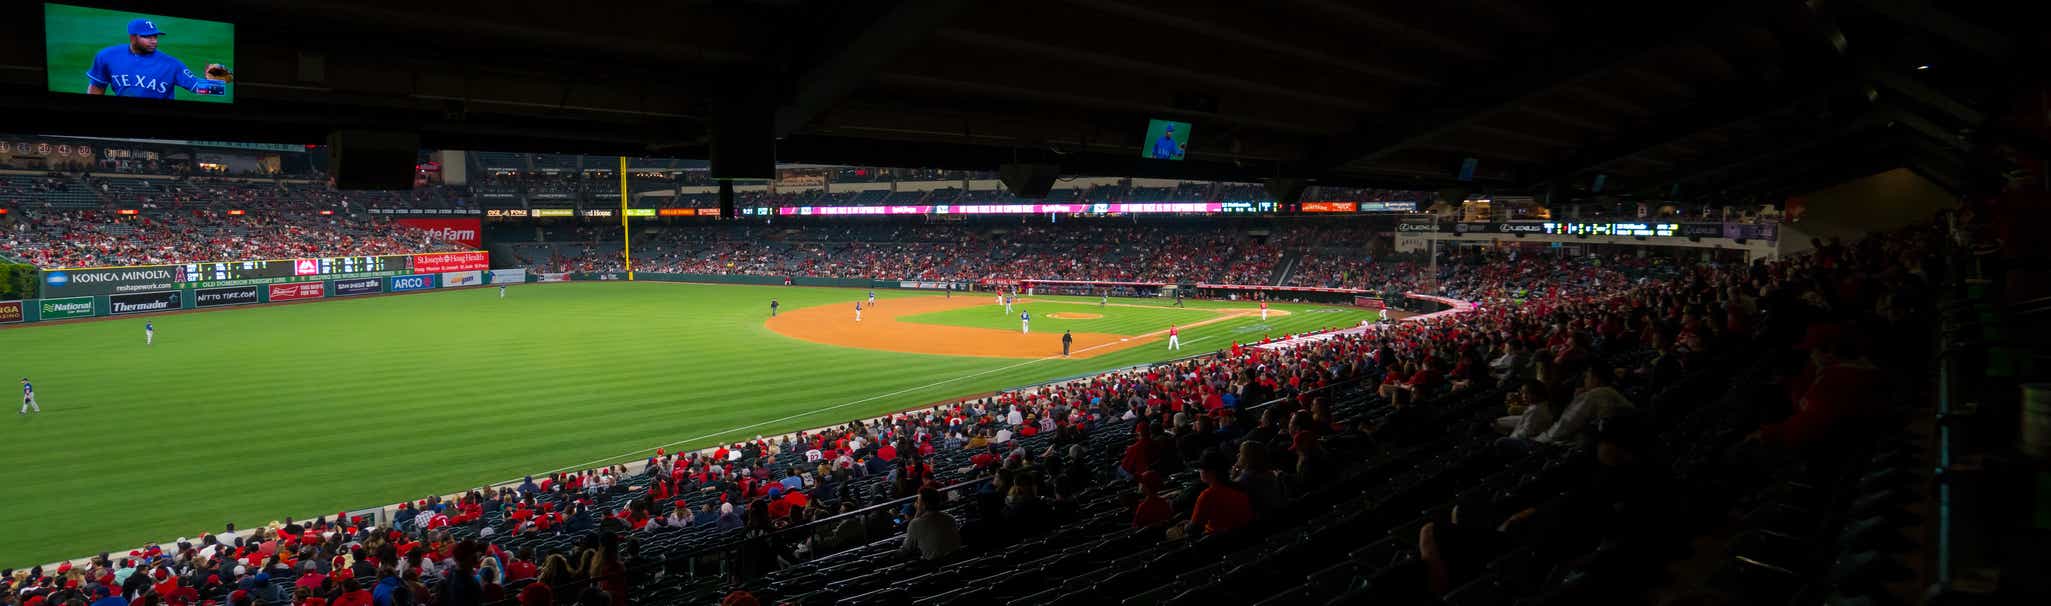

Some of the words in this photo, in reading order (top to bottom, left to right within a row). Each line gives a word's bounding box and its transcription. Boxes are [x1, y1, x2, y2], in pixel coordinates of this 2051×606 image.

[112, 74, 169, 94] TEXAS
[72, 272, 119, 283] KONICA
[121, 270, 171, 281] MINOLTA
[116, 283, 171, 292] reshapework.com
[394, 278, 422, 288] ARCO
[197, 293, 220, 302] NITTO
[54, 302, 91, 311] National
[113, 299, 168, 312] Thermador
